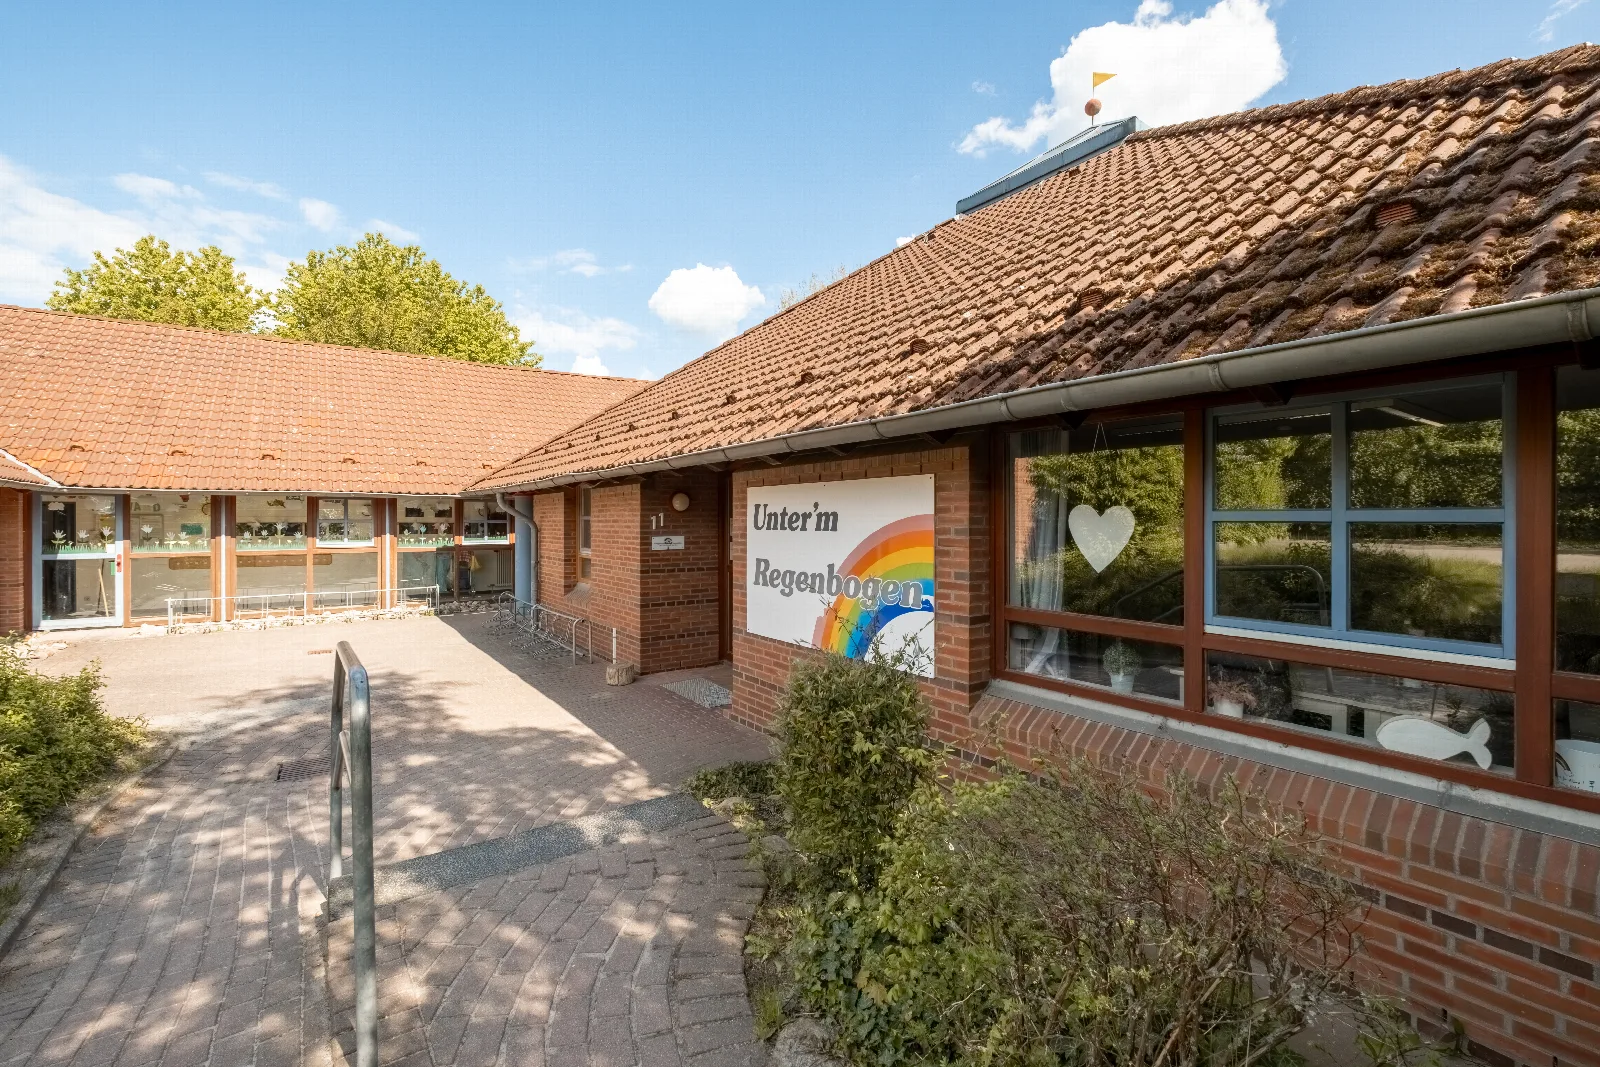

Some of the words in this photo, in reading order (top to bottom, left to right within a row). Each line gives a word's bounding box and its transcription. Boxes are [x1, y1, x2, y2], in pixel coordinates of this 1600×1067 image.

[650, 512, 664, 530] 11
[754, 502, 839, 532] Unter'm
[753, 557, 923, 611] Regenbogen
